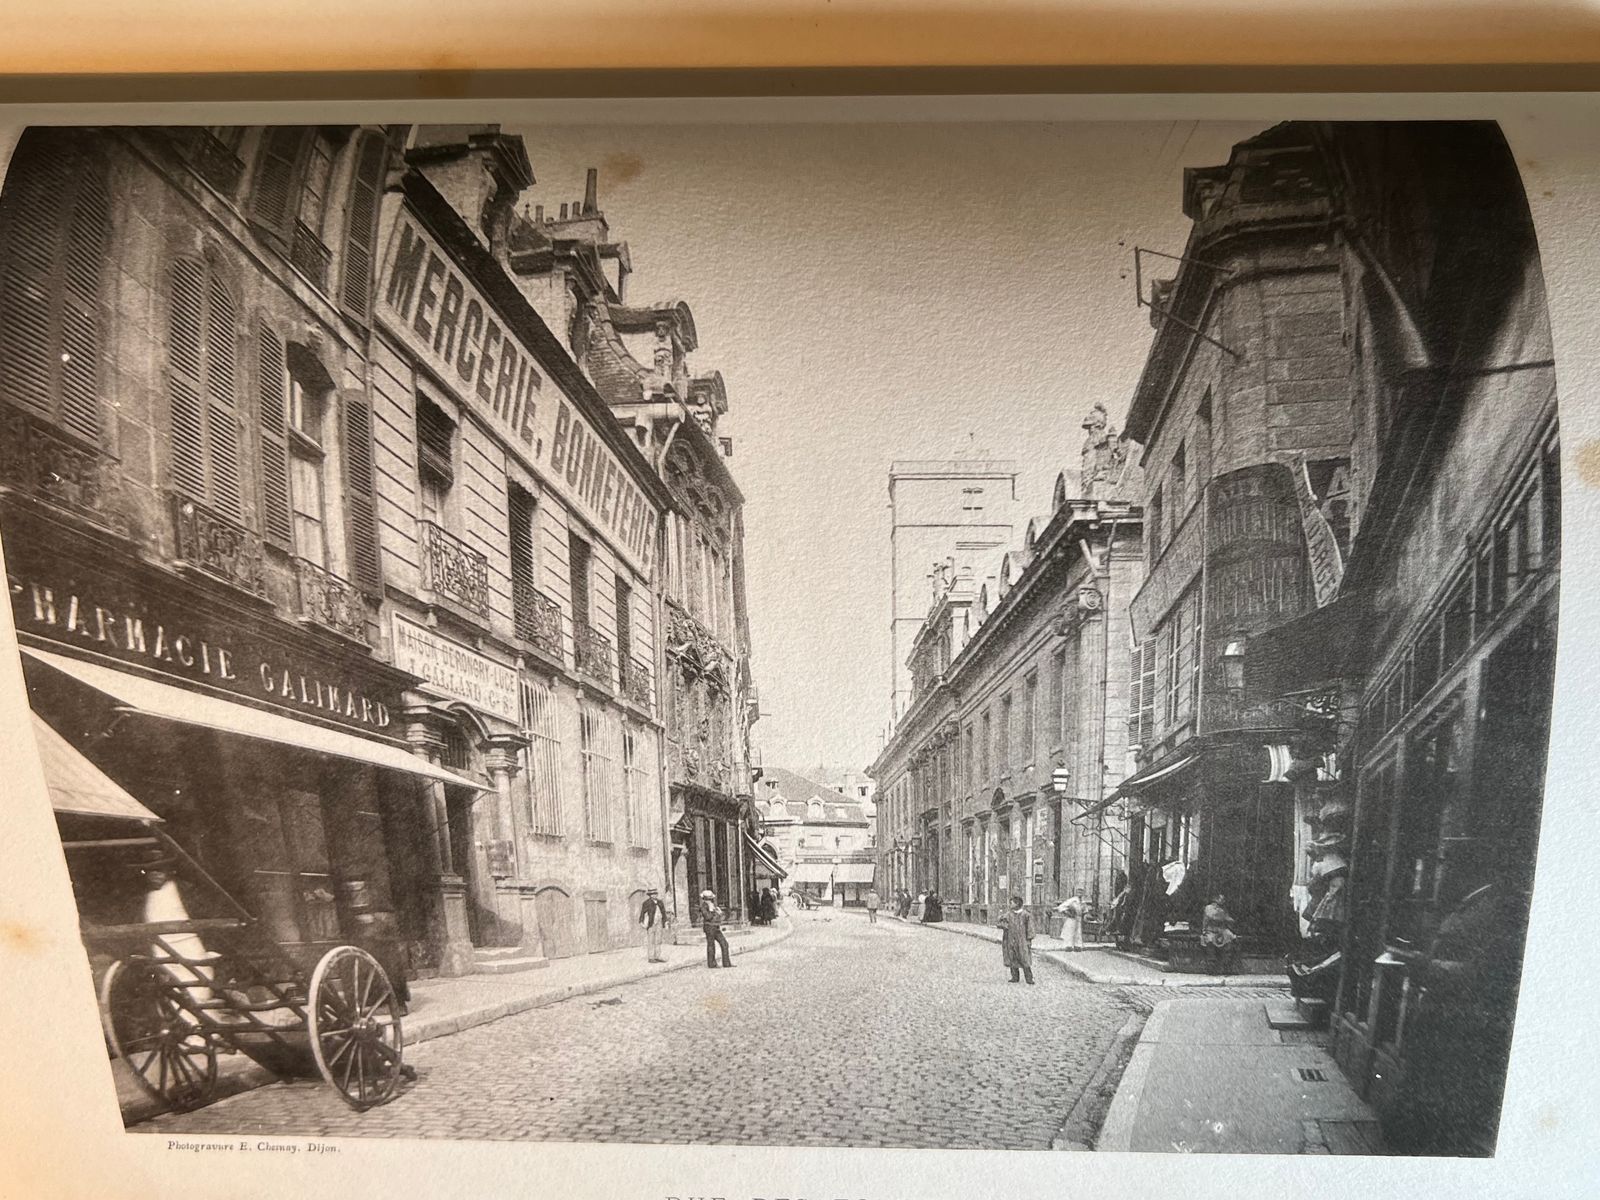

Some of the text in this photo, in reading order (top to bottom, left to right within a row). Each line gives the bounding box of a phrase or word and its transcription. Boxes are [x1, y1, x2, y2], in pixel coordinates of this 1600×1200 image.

[550, 399, 655, 566] BONNETERIE
[398, 623, 438, 660] MAISON
[259, 661, 391, 728] GALIMARD
[167, 1140, 234, 1153] Photogravure
[239, 1141, 252, 1152] E.
[307, 1142, 341, 1155] Dijon.
